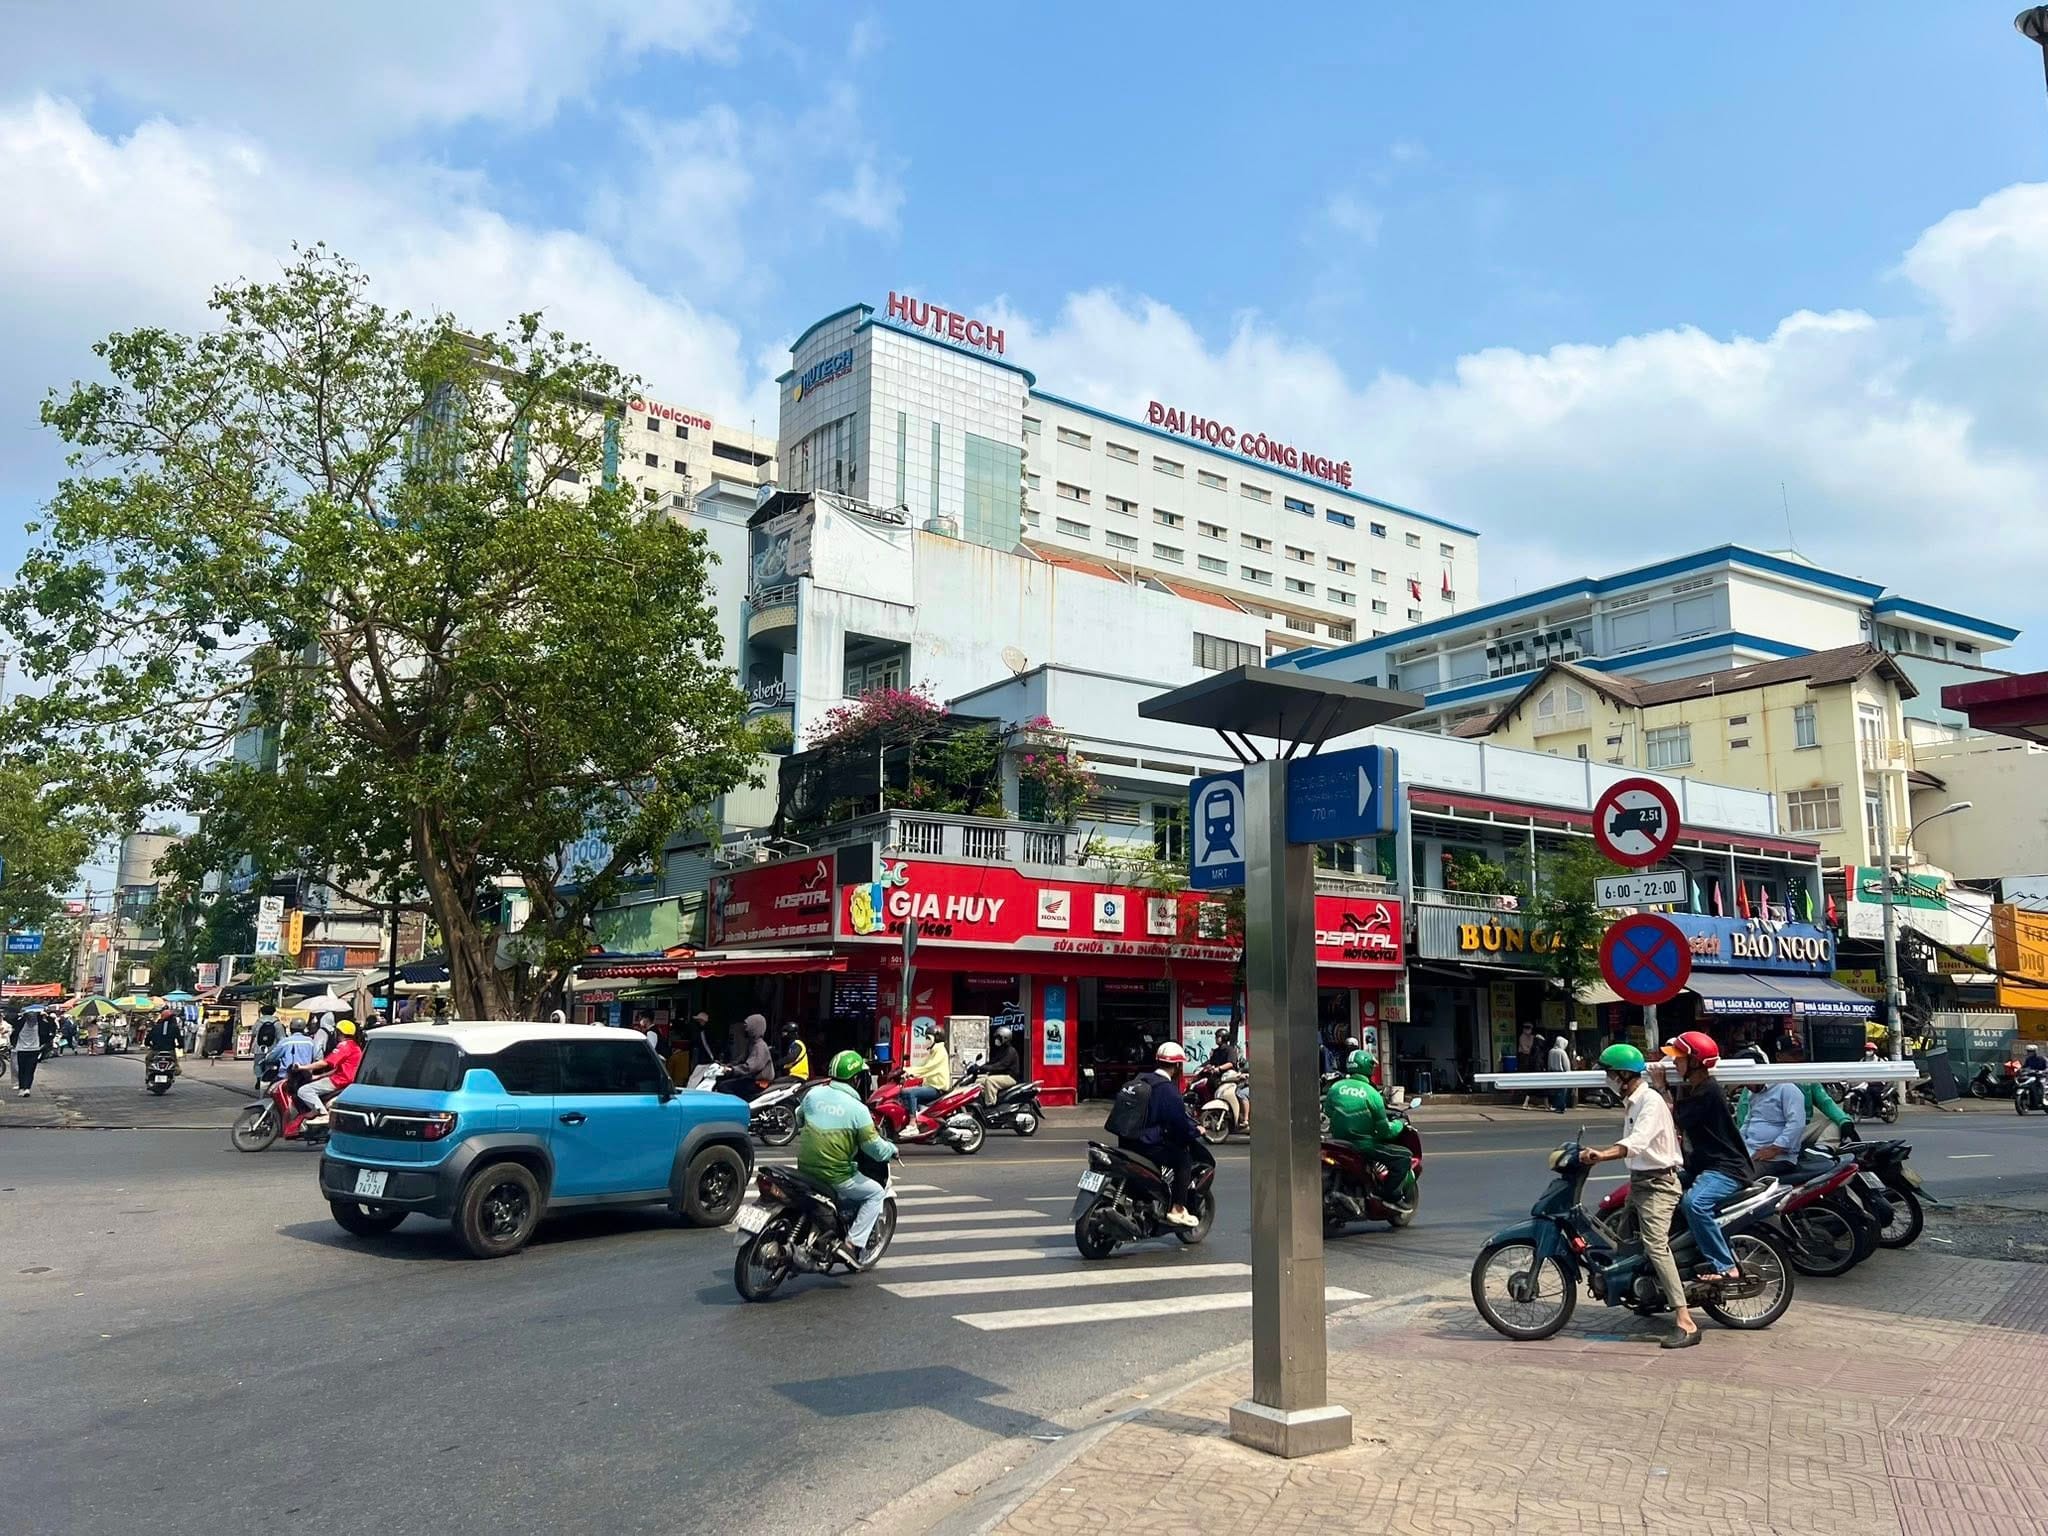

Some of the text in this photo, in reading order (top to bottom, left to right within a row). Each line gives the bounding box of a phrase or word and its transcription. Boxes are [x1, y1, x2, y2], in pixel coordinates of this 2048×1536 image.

[889, 291, 1004, 354] HUTECH
[801, 348, 853, 391] HUTECH
[649, 402, 711, 431] Welcome
[1149, 401, 1352, 489] ĐẠI HỌC CÔNG NGHỆ
[1639, 810, 1659, 822] 2.5t
[1211, 868, 1229, 880] MRT
[1605, 885, 1630, 899] 6:00
[1643, 881, 1677, 897] 22:00
[775, 890, 831, 909] HOSPITAL
[888, 890, 1005, 924] GIA HUY
[1041, 914, 1067, 922] HONDA
[1315, 930, 1398, 949] OSPITAL
[1460, 917, 1523, 952] BÚN
[258, 940, 278, 951] 7K
[1053, 939, 1074, 952] SỬA
[1076, 939, 1103, 953] CHỮA
[1113, 941, 1134, 955] BẢO
[1732, 922, 1832, 968] BẢO NGỌC
[1342, 948, 1398, 961] MOTORCYCLE
[1743, 998, 1762, 1009] BẢO
[1764, 1001, 1790, 1010] NGỌC
[1832, 1002, 1851, 1012] BẢO
[1853, 1004, 1876, 1013] NGỌC
[1339, 1084, 1367, 1099] Grab
[815, 1101, 846, 1117] Grab
